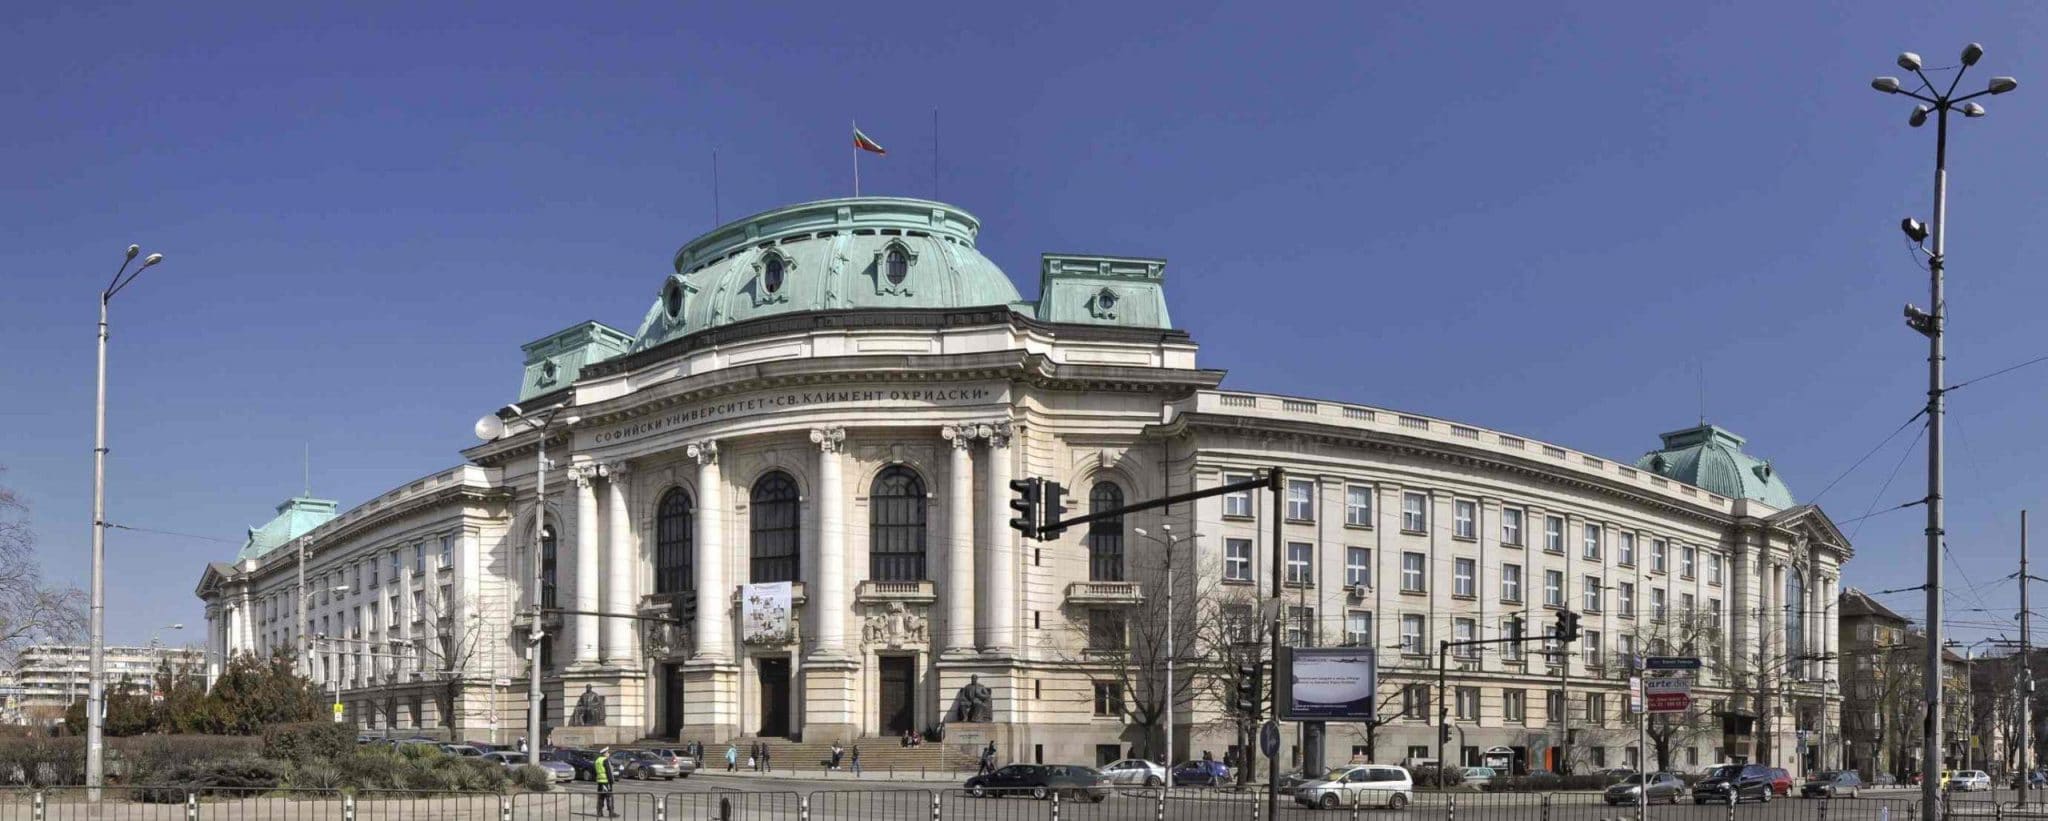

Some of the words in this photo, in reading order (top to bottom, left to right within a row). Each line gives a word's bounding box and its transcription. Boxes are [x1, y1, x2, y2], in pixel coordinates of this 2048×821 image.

[595, 419, 663, 443] СОФИЙСКИ
[666, 399, 765, 426] УНИВЕРСИТЕТ
[803, 390, 884, 402] КЛИМЕНТ
[890, 389, 982, 401] ОХРИДСКИ
